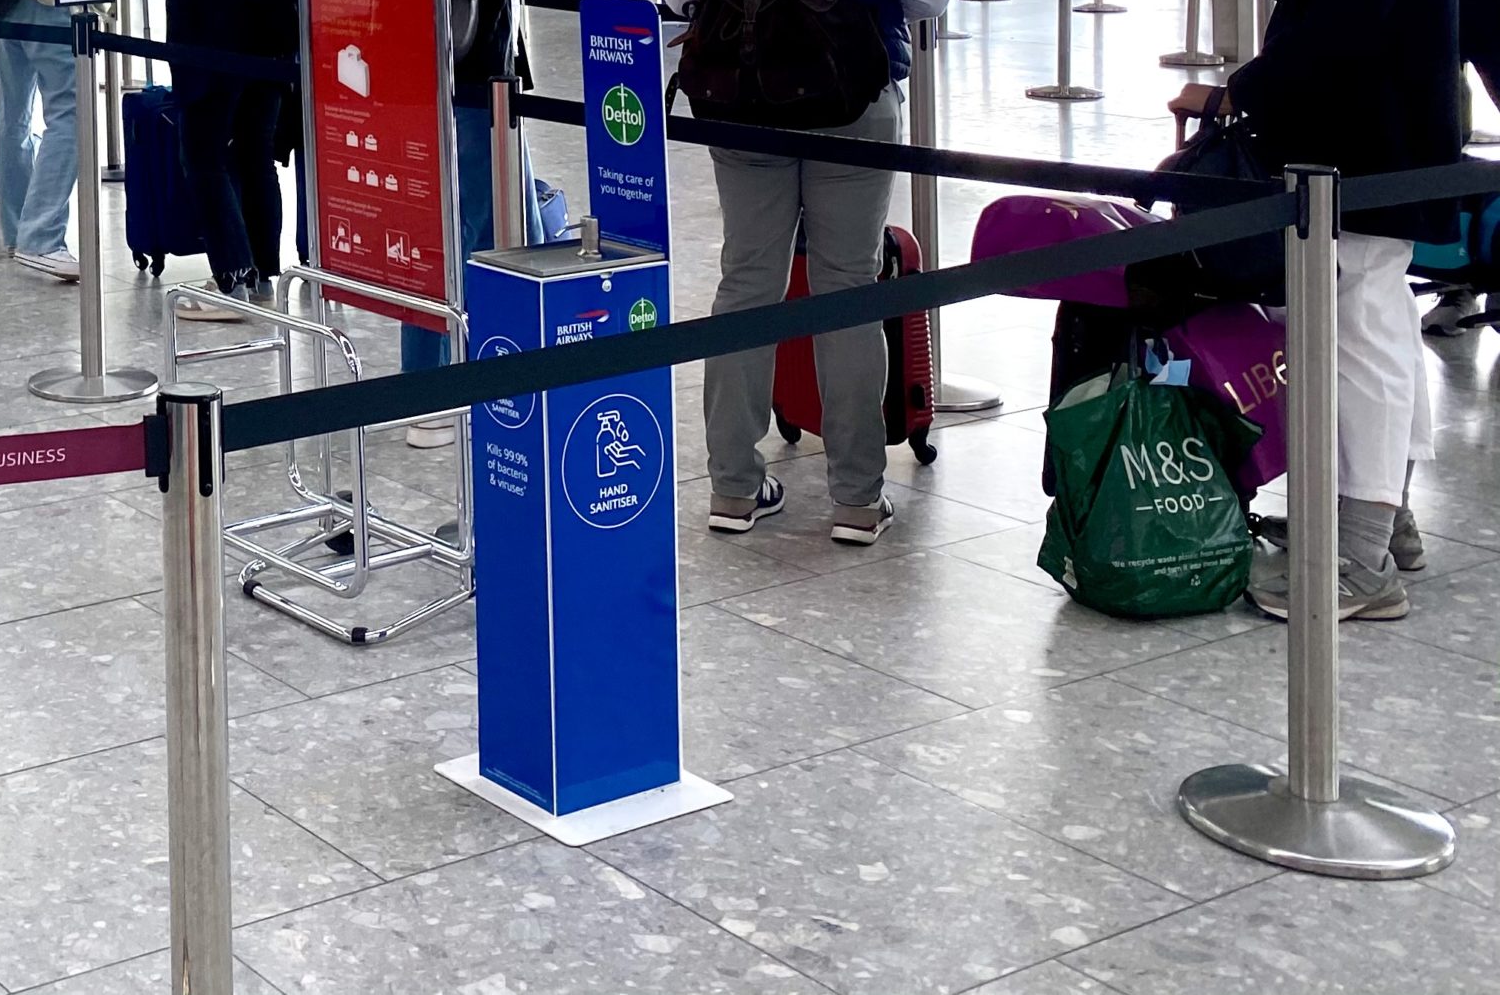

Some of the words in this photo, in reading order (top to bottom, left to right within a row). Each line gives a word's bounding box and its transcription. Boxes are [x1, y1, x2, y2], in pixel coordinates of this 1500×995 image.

[590, 35, 632, 51] BRITISH
[589, 48, 634, 65] AIRWAYS
[605, 105, 642, 126] Dettol
[597, 166, 624, 184] Taking
[625, 174, 643, 185] care
[645, 176, 654, 187] of
[600, 184, 616, 195] you
[617, 186, 652, 202] together
[630, 311, 655, 325] Dettol
[557, 321, 593, 336] BRITISH
[555, 331, 594, 346] AIRWAYS
[491, 403, 520, 420] SANITISER
[486, 441, 503, 458] Kills
[503, 448, 529, 467] 99.9%
[487, 459, 496, 470] of
[497, 460, 529, 483] bacteria
[1120, 437, 1214, 490] M&S
[489, 472, 496, 486] &
[599, 483, 629, 499] HAND
[589, 495, 639, 515] SANITISER
[1154, 494, 1206, 516] FOOD
[1128, 558, 1156, 568] recycle
[1157, 556, 1177, 564] waste
